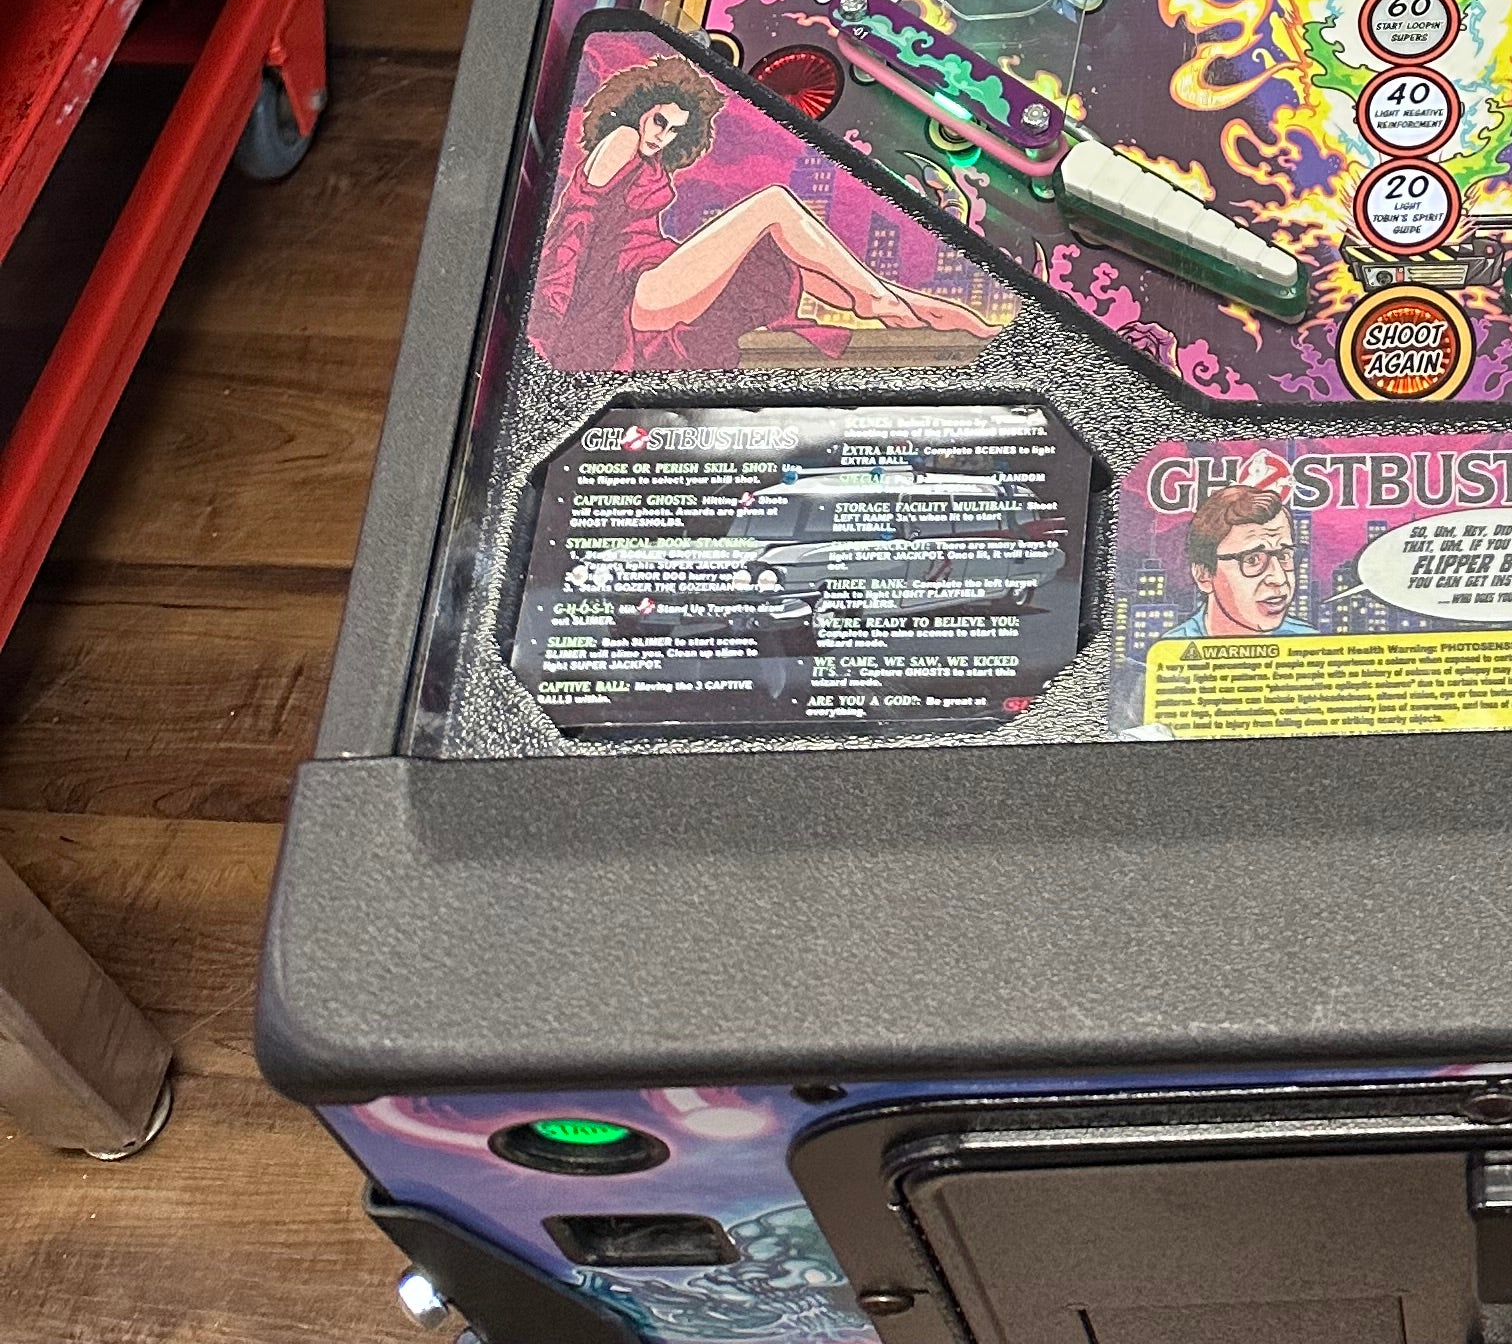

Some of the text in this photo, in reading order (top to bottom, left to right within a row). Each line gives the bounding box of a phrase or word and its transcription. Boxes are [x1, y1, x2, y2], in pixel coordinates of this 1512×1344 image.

[1376, 21, 1403, 31] START
[1391, 33, 1428, 42] SUPERS
[1387, 82, 1430, 105] 40
[1374, 108, 1444, 118] LIGHT NEGATIVE
[1385, 175, 1429, 199] 20
[1394, 201, 1421, 211] LIGHT
[1373, 212, 1444, 223] TOBIN'S SPIRIT
[1393, 224, 1421, 235] GUIDE
[1364, 322, 1445, 348] SHOOT
[1364, 351, 1442, 377] AGAIN
[842, 444, 882, 456] EXTRA
[579, 462, 778, 475] CHOOSE OR PERISH SKILL SHOT:
[573, 494, 642, 506] CAPTURING
[835, 502, 949, 513] STORAGE FACILITY
[1411, 554, 1495, 576] FLIPPER
[824, 579, 867, 590] THREE
[866, 617, 986, 628] READY BELIEVE
[1203, 645, 1280, 660] WARNING
[973, 656, 1020, 667] KICKED
[538, 681, 591, 692] CAPTIVE
[807, 695, 866, 706] ARE YOU
